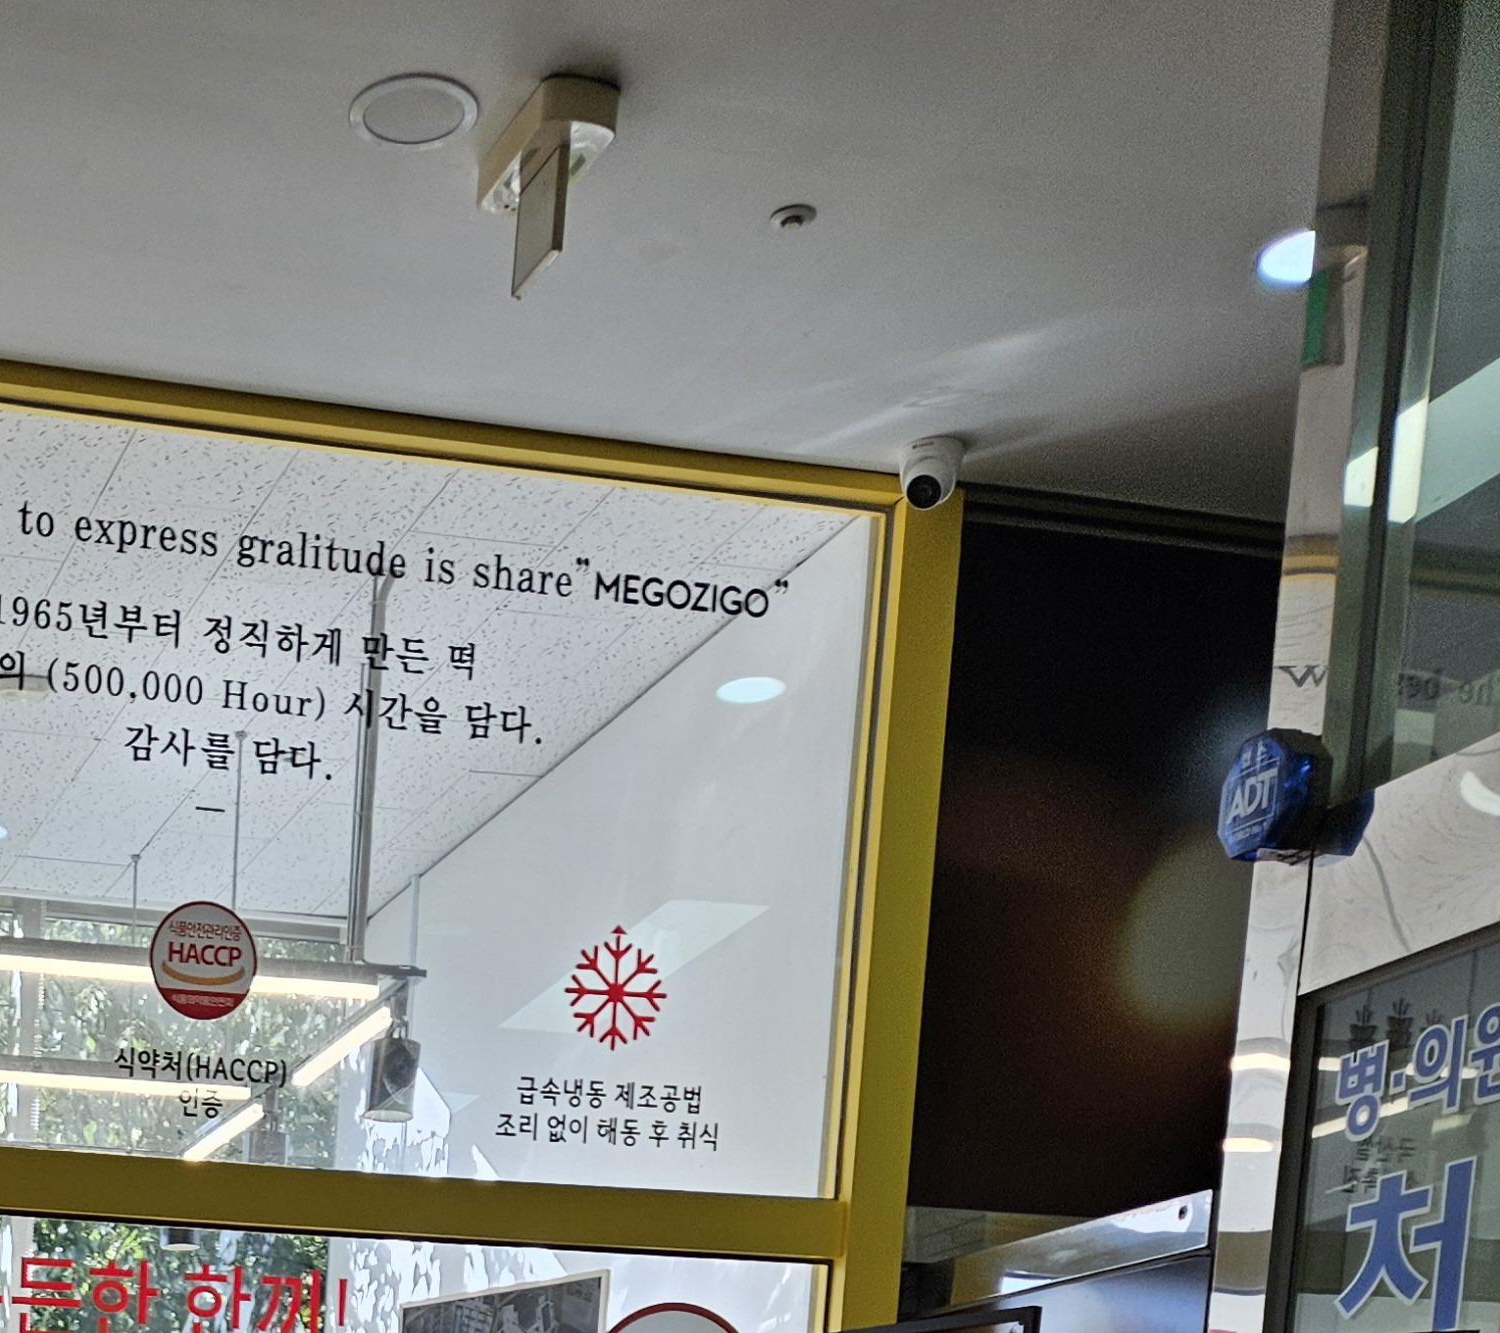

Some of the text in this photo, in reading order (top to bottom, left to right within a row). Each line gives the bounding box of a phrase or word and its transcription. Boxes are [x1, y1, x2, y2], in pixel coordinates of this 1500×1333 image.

[18, 500, 56, 539] to
[74, 510, 220, 558] express
[236, 529, 407, 581] gralitude
[424, 547, 457, 585] is
[202, 613, 343, 668] 정직하게
[361, 631, 430, 677] 만든
[448, 642, 477, 680] 떡
[221, 677, 327, 722] Hour)
[343, 688, 448, 736] 시간을
[465, 703, 544, 746] 담다.
[122, 721, 334, 783] 감사를 담다.
[1227, 767, 1279, 826] ADT
[167, 938, 245, 970] HACCP
[112, 1046, 288, 1090] 식약처(HACCP)
[176, 1087, 226, 1120] 인증
[516, 1074, 704, 1117] 급속냉동 제조공법
[494, 1111, 721, 1153] 조리 없이 해동 후 취식
